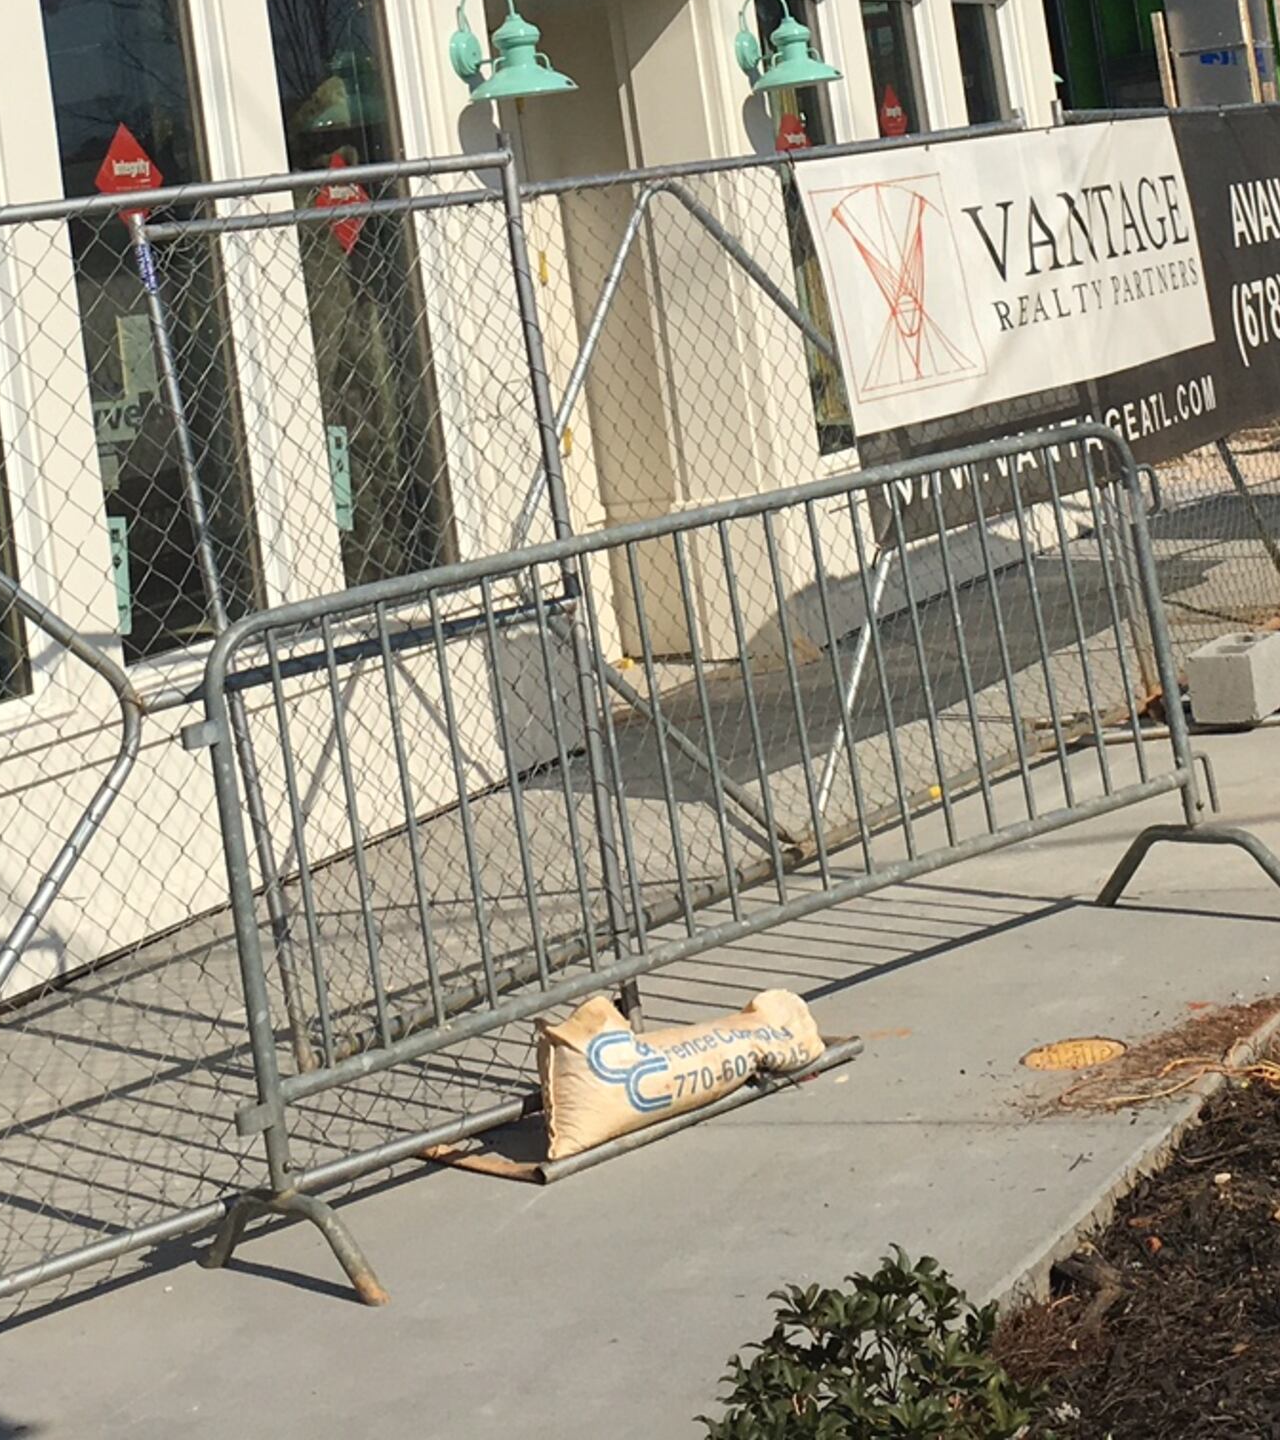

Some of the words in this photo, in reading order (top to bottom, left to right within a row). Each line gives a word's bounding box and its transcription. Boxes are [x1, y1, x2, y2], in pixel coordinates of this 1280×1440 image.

[961, 174, 1189, 282] VANTAGE
[992, 279, 1103, 331] REALTY
[1110, 257, 1199, 305] PARTNERS
